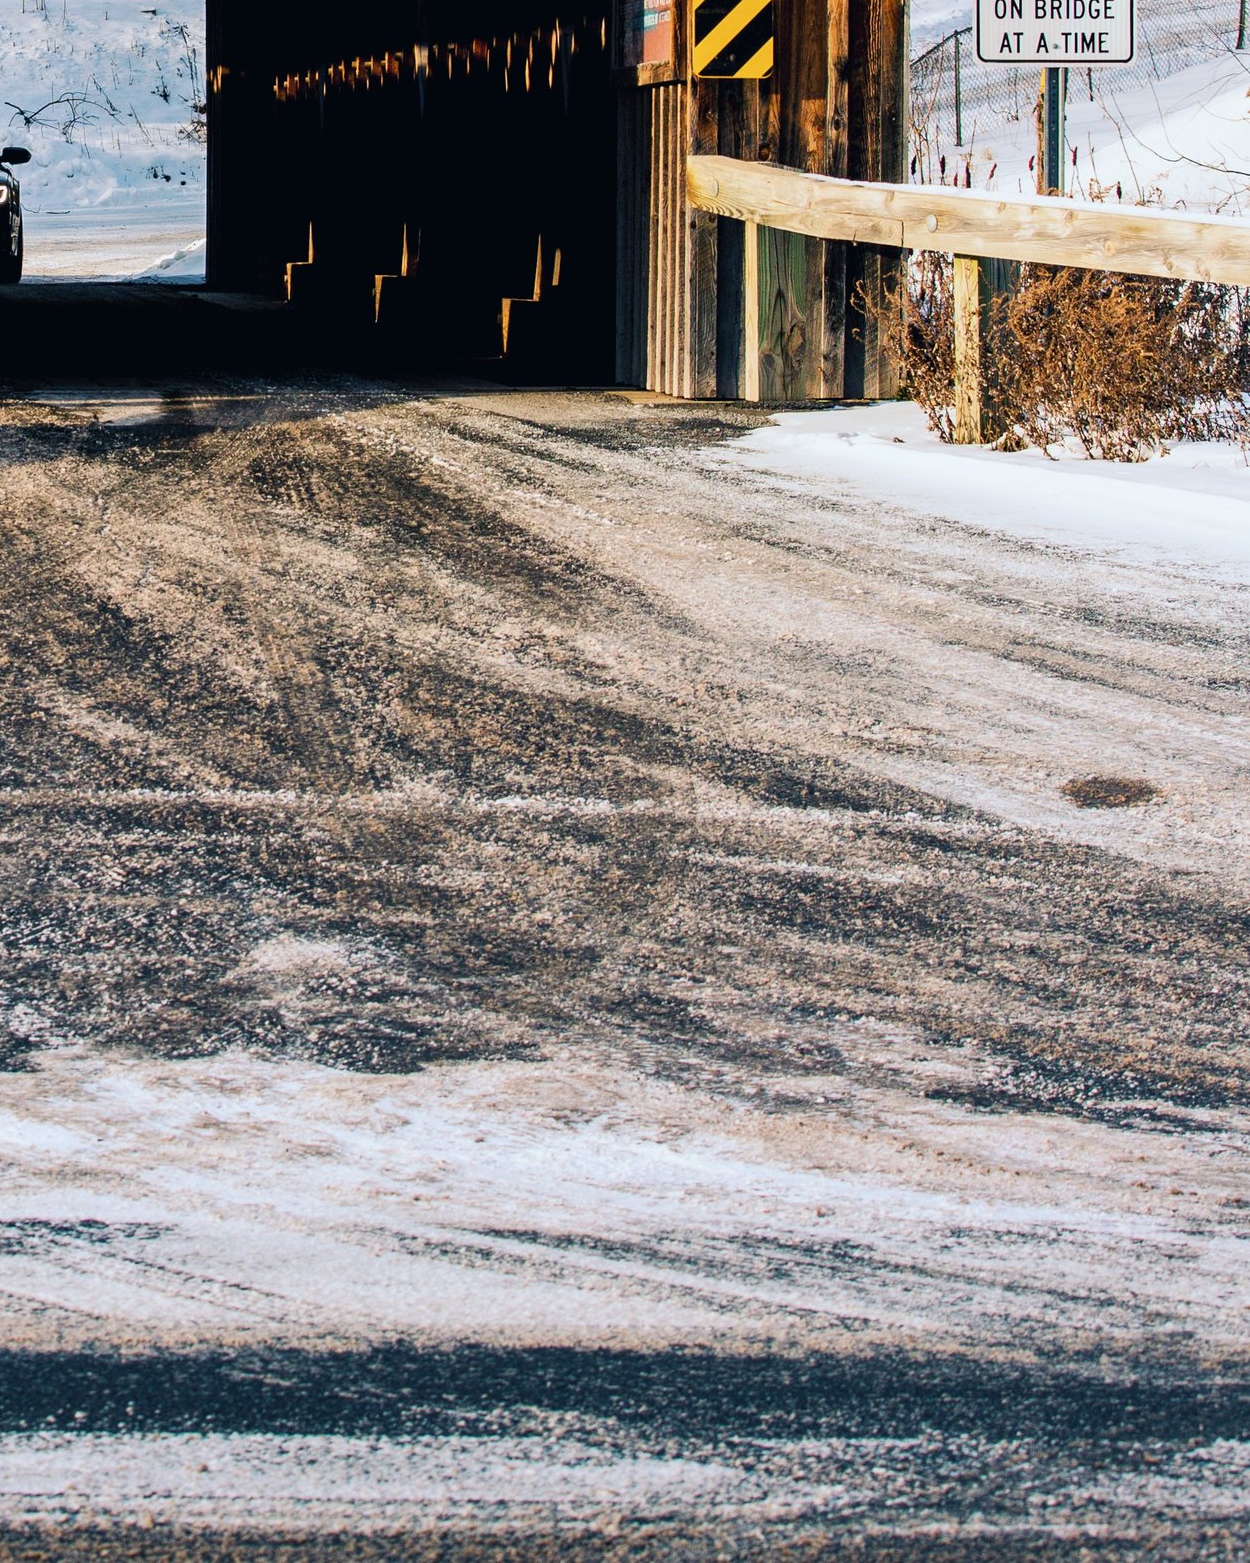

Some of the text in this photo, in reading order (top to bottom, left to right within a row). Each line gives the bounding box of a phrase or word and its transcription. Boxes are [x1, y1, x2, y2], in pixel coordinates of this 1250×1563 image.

[1000, 32, 1110, 54] AT A TIME
